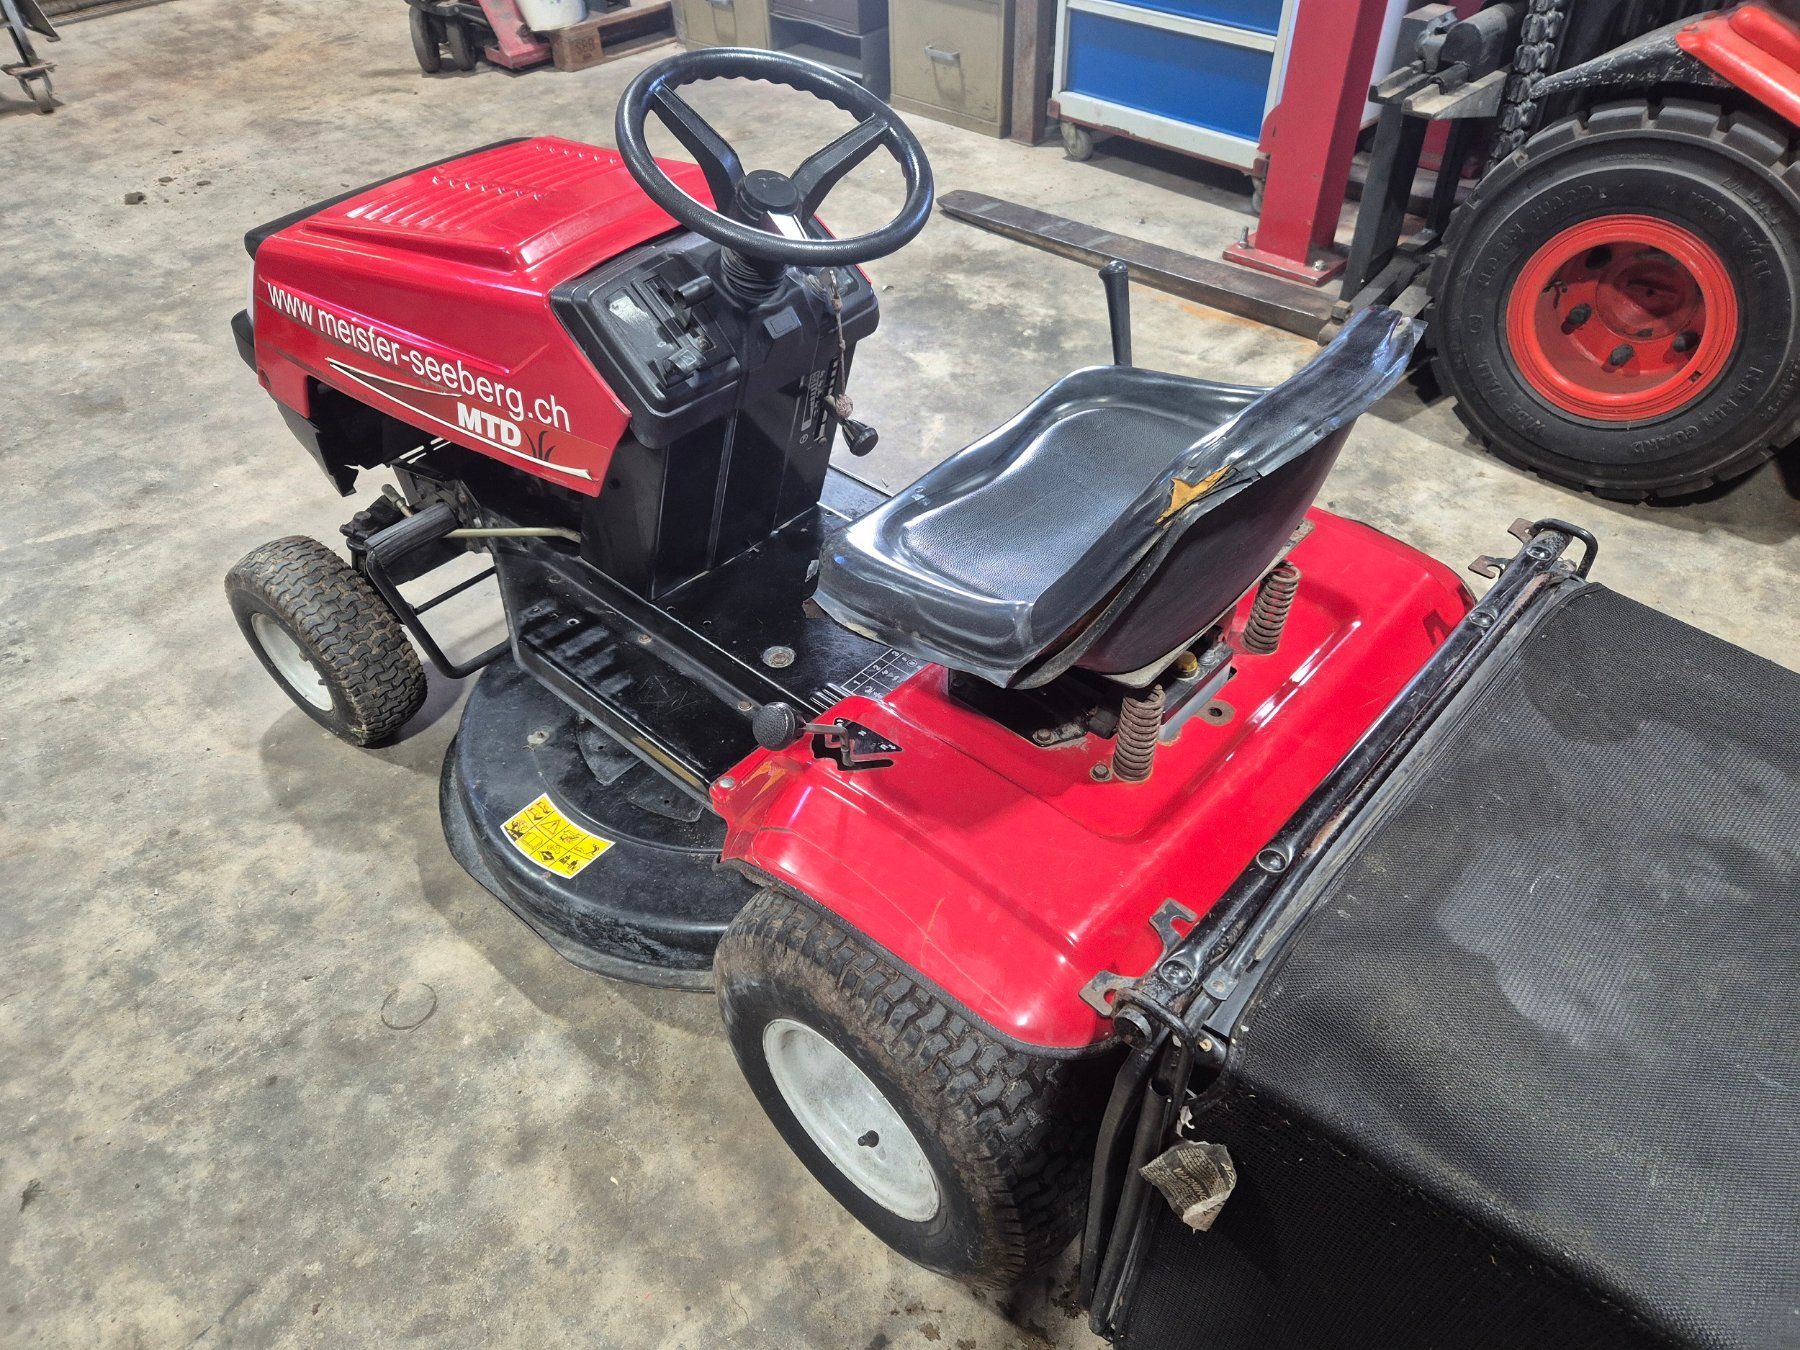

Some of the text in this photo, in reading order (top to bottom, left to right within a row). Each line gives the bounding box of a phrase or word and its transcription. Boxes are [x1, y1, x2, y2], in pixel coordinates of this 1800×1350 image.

[267, 283, 572, 432] www meister-seeberg.ch
[457, 402, 522, 447] MTD
